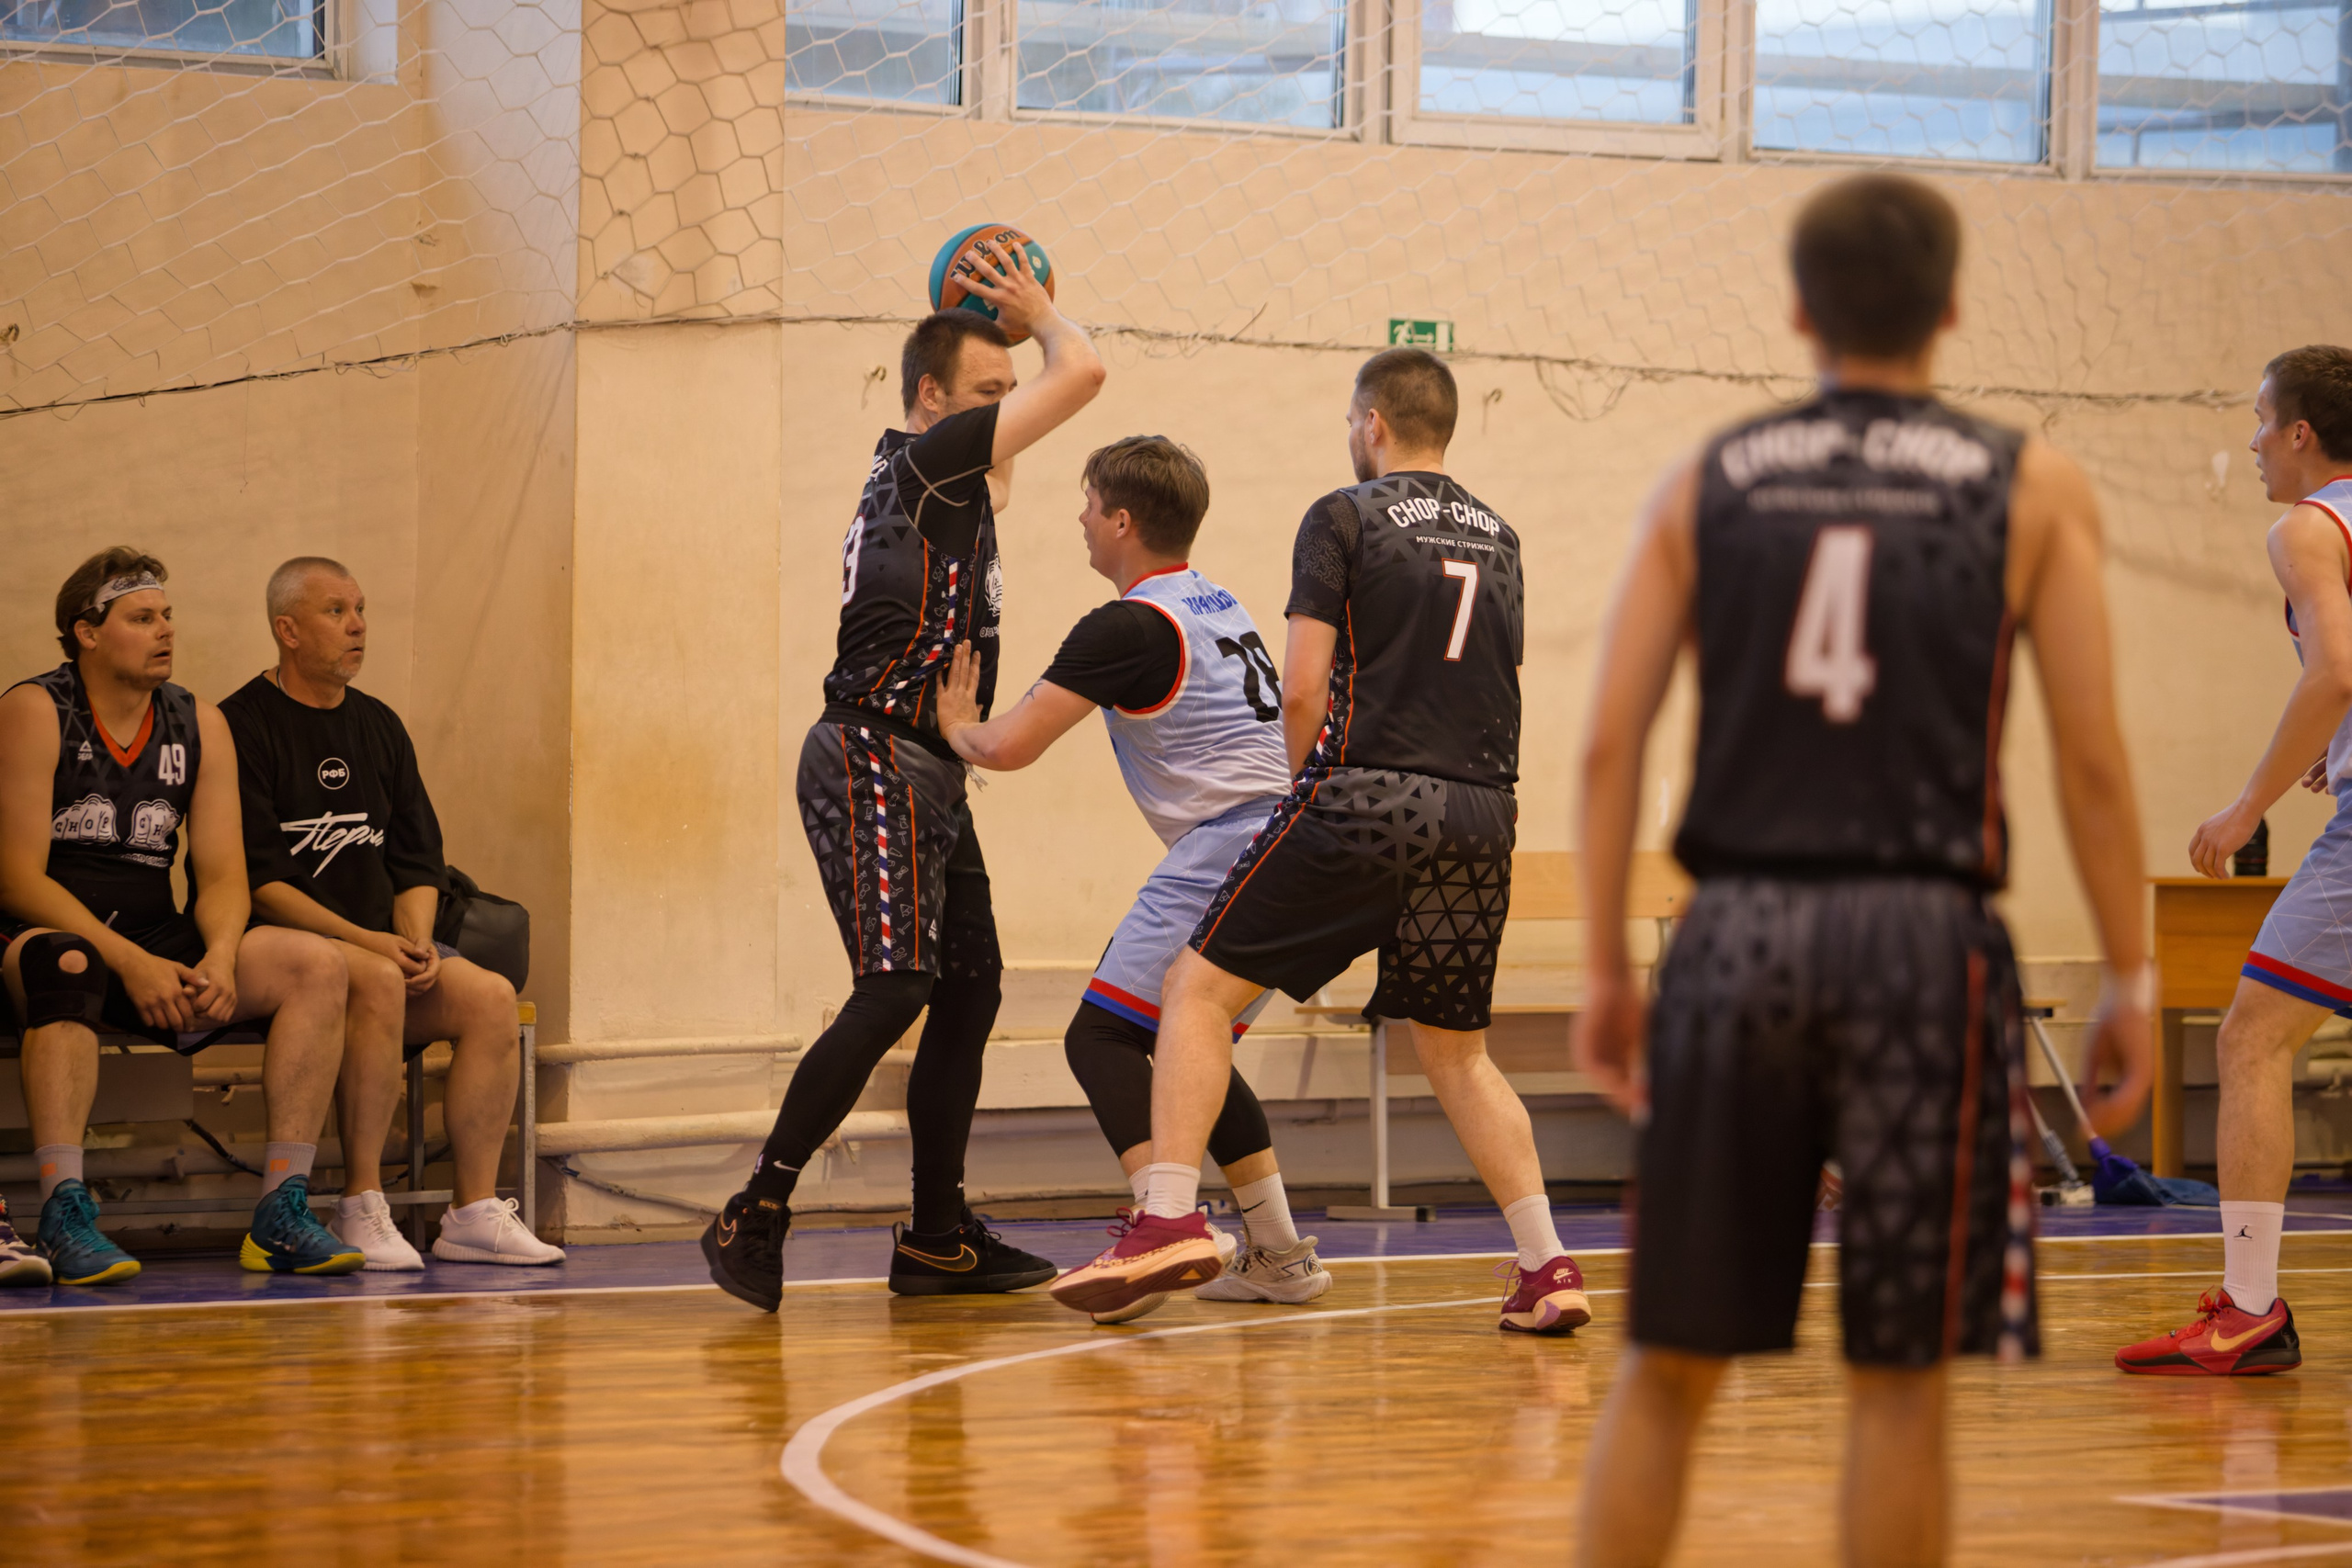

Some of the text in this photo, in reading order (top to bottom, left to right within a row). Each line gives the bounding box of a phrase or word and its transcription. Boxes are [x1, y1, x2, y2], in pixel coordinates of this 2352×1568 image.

[949, 229, 1022, 280] Wlon
[1386, 497, 1500, 536] CHOP-CHOP
[1416, 536, 1496, 553] МУЖСКИЕ СТРИЖКИ
[1442, 558, 1479, 662] 7
[1783, 523, 1879, 723] 4
[158, 743, 186, 785] 49
[322, 768, 346, 780] РФБ
